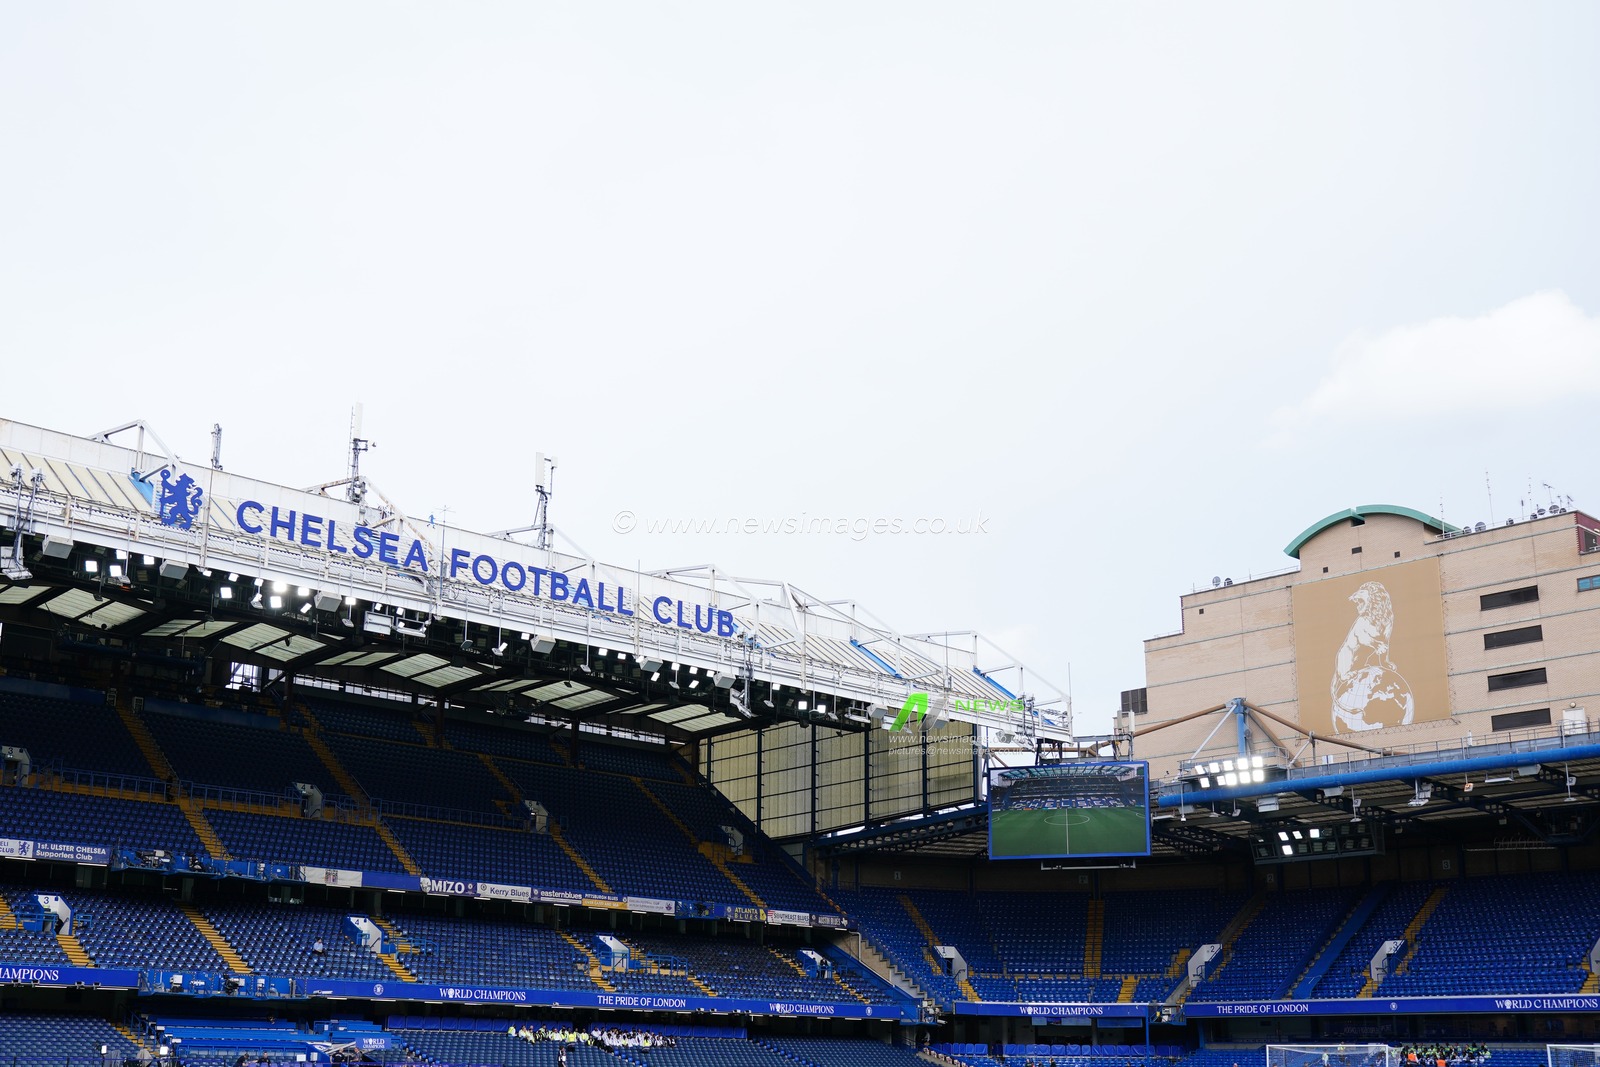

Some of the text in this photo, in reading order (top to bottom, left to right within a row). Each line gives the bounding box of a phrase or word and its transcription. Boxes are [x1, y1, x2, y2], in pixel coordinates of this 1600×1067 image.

[236, 500, 735, 637] CHELSEA FOOTBALL CLUB
[8, 746, 14, 754] 3
[37, 842, 106, 855] 1st. ULSTER CHELSEA
[36, 850, 93, 861] Supporters Club
[431, 879, 465, 894] MIZO
[490, 887, 530, 898] Kerry Blues
[540, 890, 582, 900] easternblues
[43, 896, 50, 904] 3
[734, 907, 758, 915] ATLANTA
[474, 989, 526, 1001] CHAMPIONS
[597, 995, 686, 1008] THE PRIDE OF LONDON
[1533, 998, 1599, 1009] CHAMPIONS
[794, 1004, 835, 1014] CHAMPIONS
[1051, 1006, 1104, 1015] CHAMPIONS
[1216, 1003, 1309, 1014] THE PRIDE OF LONDON
